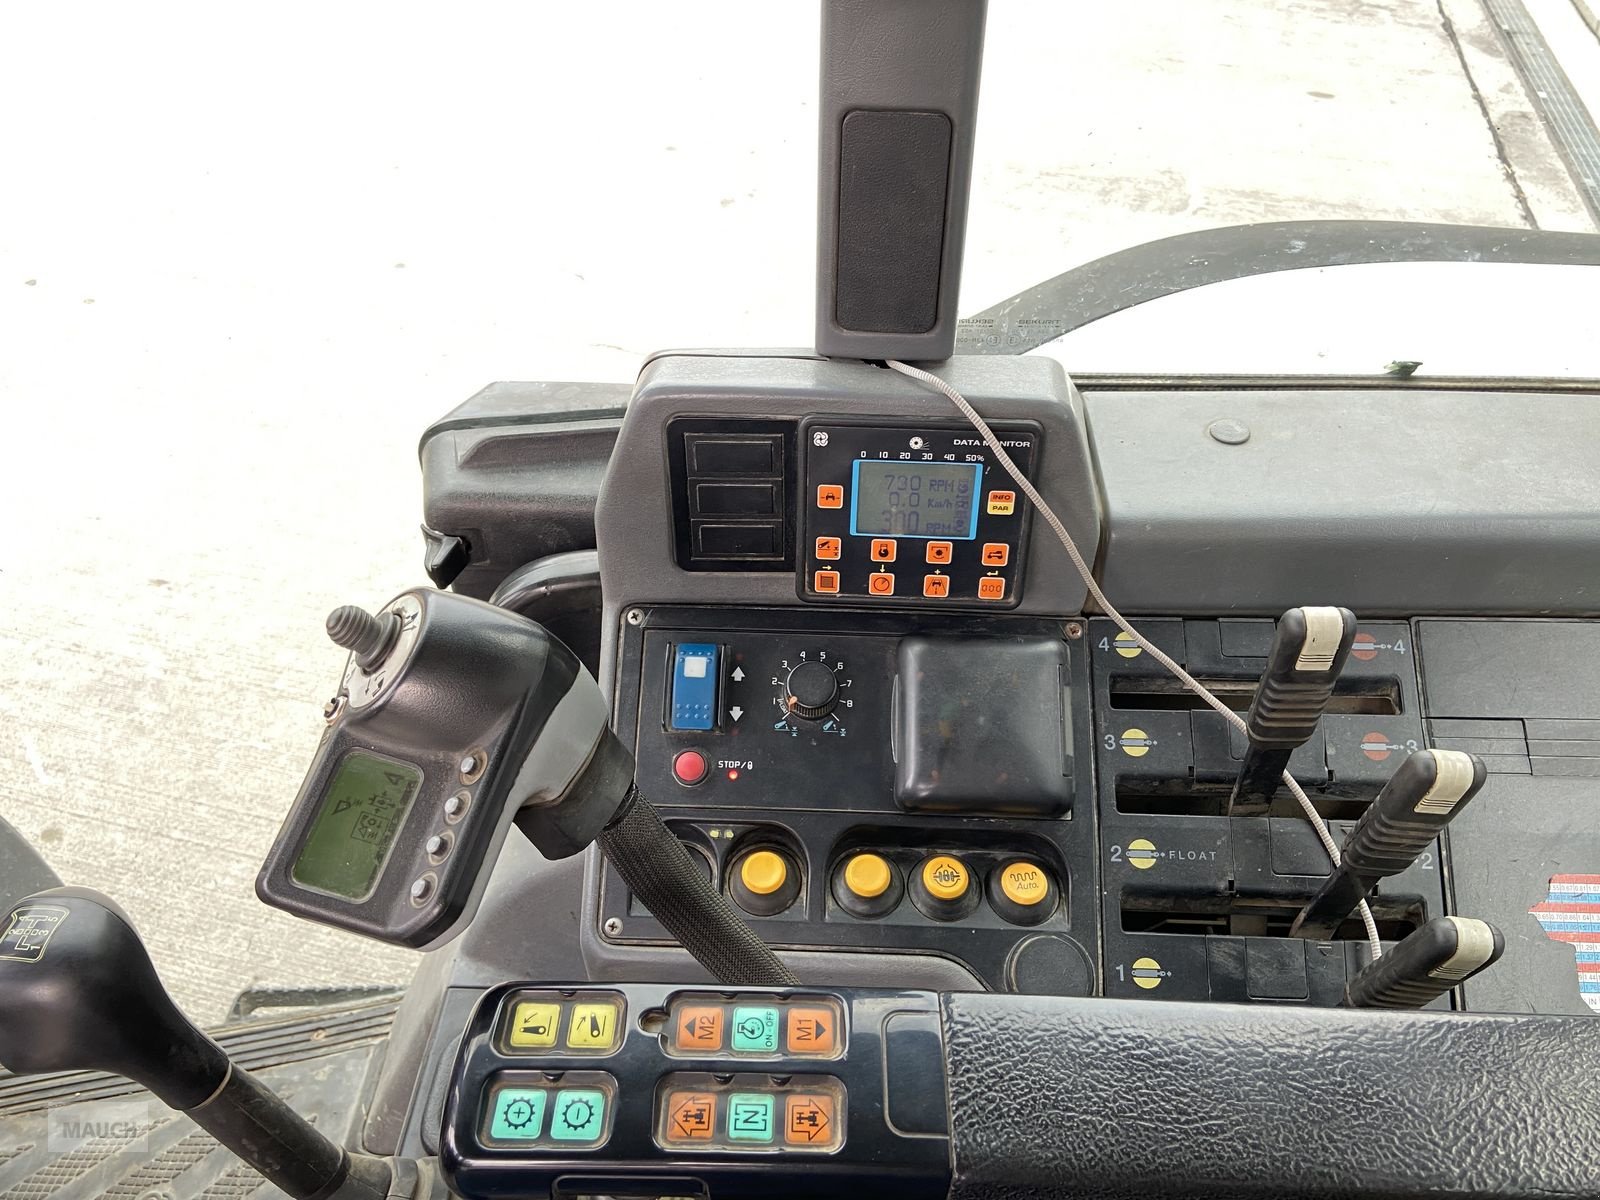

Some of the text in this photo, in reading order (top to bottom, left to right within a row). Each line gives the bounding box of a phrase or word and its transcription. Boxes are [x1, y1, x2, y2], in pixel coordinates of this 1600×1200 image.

[953, 438, 1031, 448] DATA MNITOR
[879, 451, 889, 459] 10
[900, 452, 911, 460] 20
[922, 452, 933, 460] 30
[944, 453, 956, 461] 40
[965, 454, 984, 462] 50%
[884, 474, 954, 492] 730 RPM
[888, 492, 920, 508] 0.0
[1098, 637, 1110, 652] 4
[1394, 639, 1406, 655] 4
[800, 650, 806, 658] 4
[820, 652, 826, 660] 5
[846, 700, 853, 708] 8
[1104, 734, 1116, 750] 3
[1406, 739, 1418, 755] 3
[1110, 846, 1217, 862] 2 FLOAT
[1421, 852, 1434, 870] 2
[1116, 964, 1124, 981] 1
[698, 1015, 715, 1040] M2
[766, 1011, 774, 1028] OFF
[796, 1019, 812, 1041] M1
[766, 1034, 773, 1047] ON
